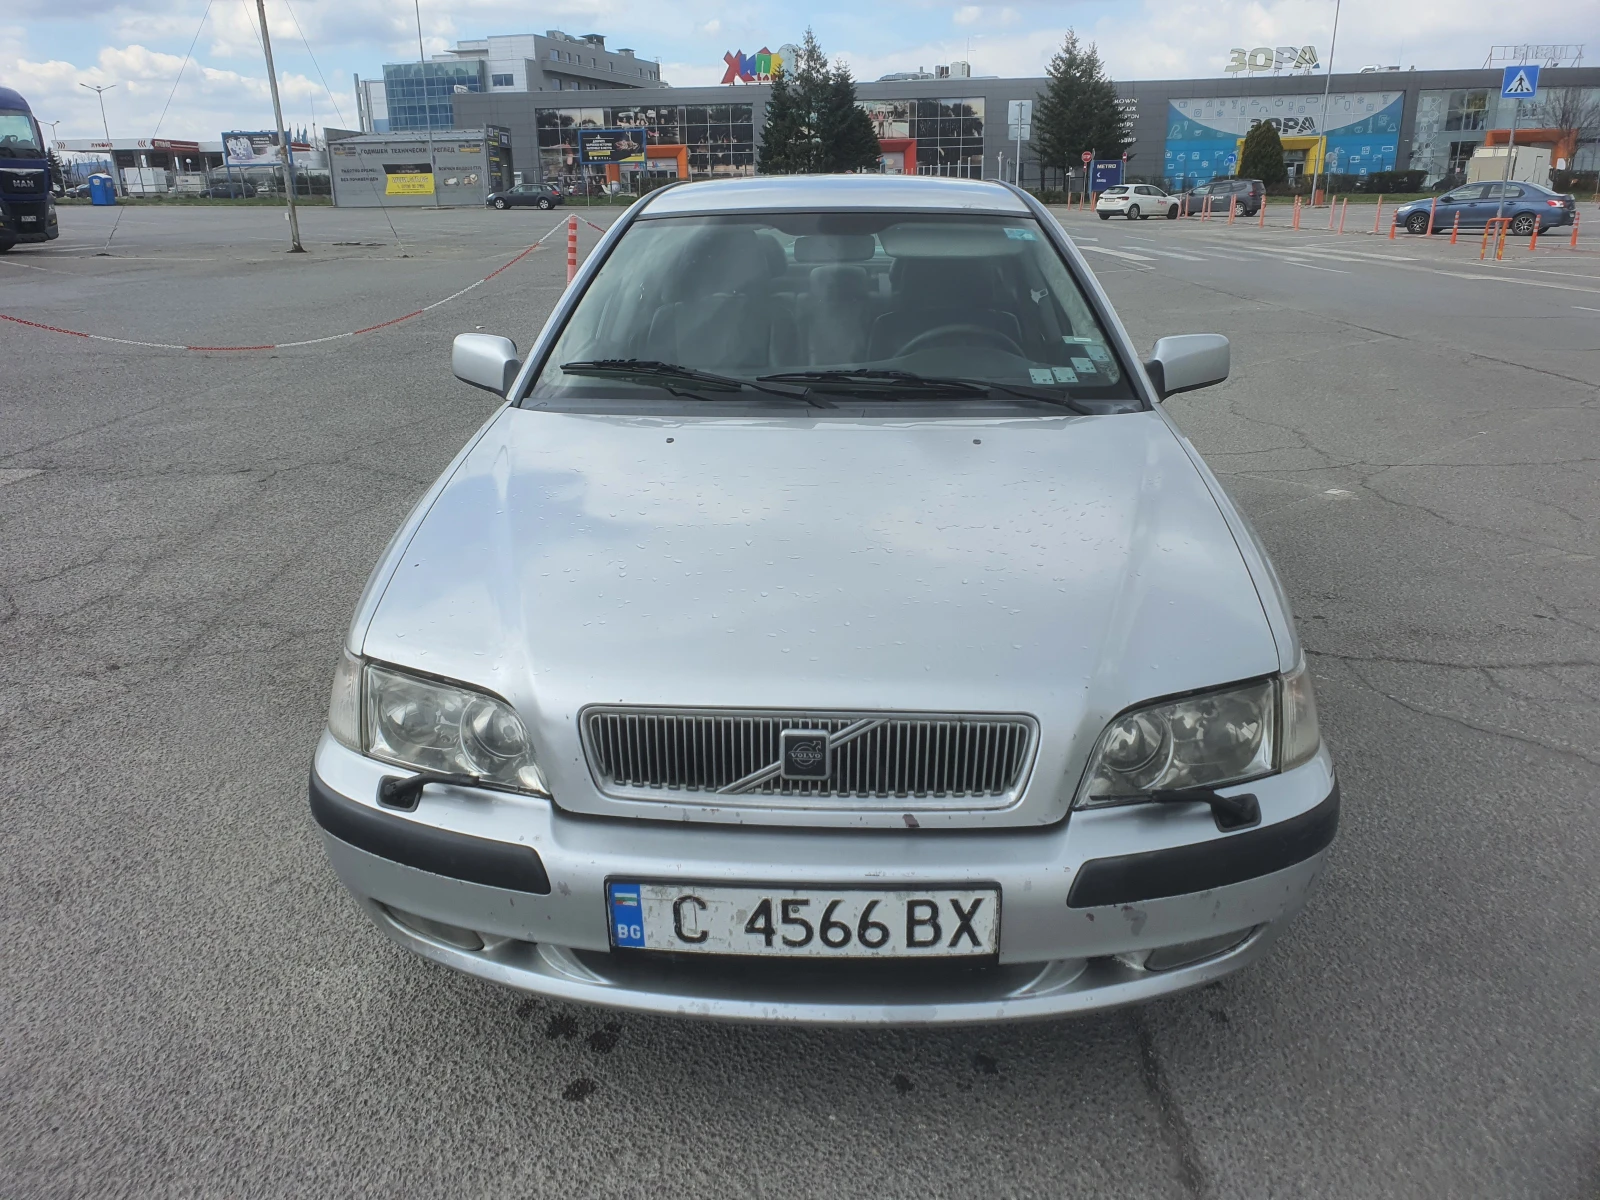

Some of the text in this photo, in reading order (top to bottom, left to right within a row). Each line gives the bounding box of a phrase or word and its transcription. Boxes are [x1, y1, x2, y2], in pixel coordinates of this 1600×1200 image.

[1224, 46, 1318, 72] ЗОРА
[433, 146, 456, 154] РЕГЛЕД
[12, 179, 35, 188] MAN
[672, 895, 984, 949] C 4566 BX
[617, 923, 641, 940] BG
